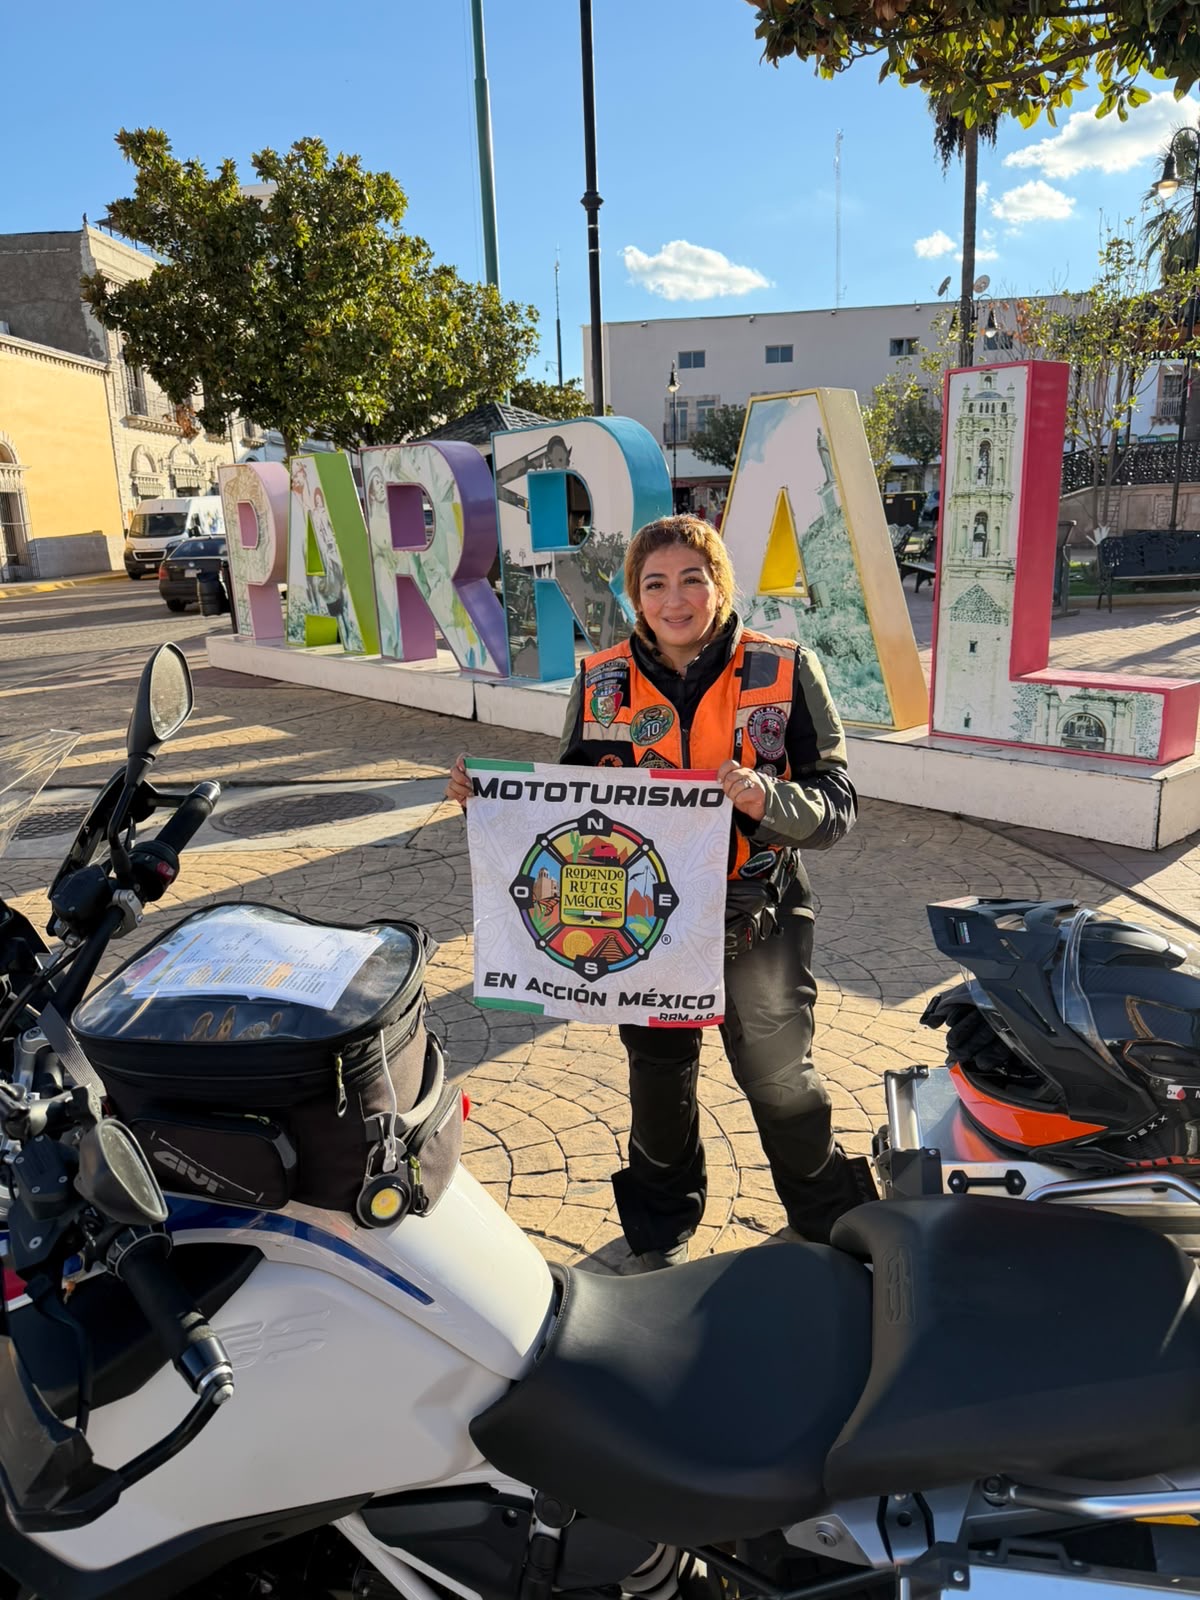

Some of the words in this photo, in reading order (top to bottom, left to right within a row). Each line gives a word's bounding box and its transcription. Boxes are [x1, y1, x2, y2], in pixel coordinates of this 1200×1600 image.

[218, 358, 1200, 764] PARRAL
[646, 722, 660, 737] 10
[472, 777, 725, 808] MOTOTURISMO
[587, 817, 603, 830] N
[514, 886, 529, 898] O
[659, 894, 672, 907] E
[585, 962, 598, 975] S
[484, 971, 517, 989] EN
[525, 977, 607, 1007] ACCIÓN
[618, 987, 716, 1010] MÉXICO
[153, 1150, 225, 1194] GIVI
